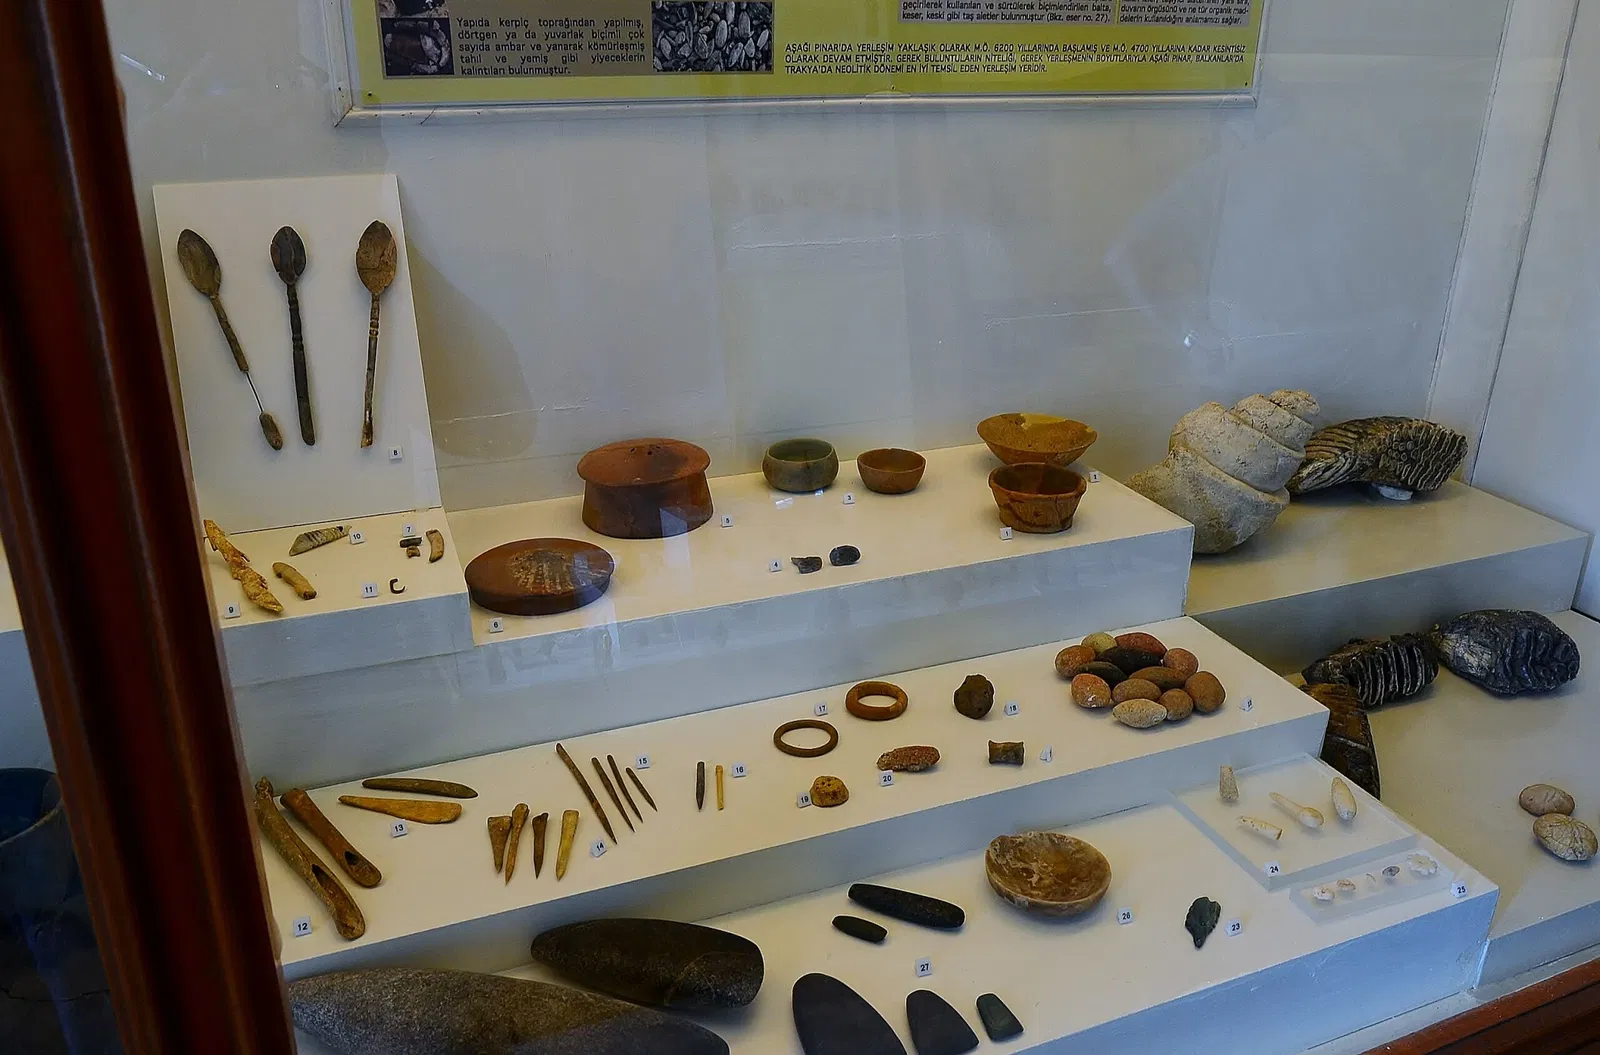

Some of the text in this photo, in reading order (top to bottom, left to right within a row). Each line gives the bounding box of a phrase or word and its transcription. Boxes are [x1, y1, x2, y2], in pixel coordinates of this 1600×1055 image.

[946, 0, 981, 9] kullanılan
[998, 2, 1035, 10] sürtülerek
[1092, 3, 1111, 13] balta,
[903, 11, 923, 20] keser,
[926, 11, 944, 20] keski
[947, 12, 960, 21] gibi
[963, 12, 974, 21] taş
[976, 12, 998, 20] aletler
[1001, 12, 1044, 22] bulunmuştur
[1047, 13, 1063, 22] (Bkz.
[1095, 13, 1110, 23] 27).
[457, 18, 644, 28] Yapıda kerpiç toprağından yapılmış,
[458, 30, 645, 40] dörtgen ya da yuvarlak biçimli çok
[459, 43, 490, 54] sayıda
[495, 43, 525, 51] ambar
[546, 42, 583, 52] yanarak
[588, 42, 645, 52] kömürleşmiş
[785, 42, 810, 54] AŞAĞI
[814, 43, 852, 52] PINAR'DA
[857, 42, 894, 53] YERLEŞİM
[898, 44, 936, 54] YAKLAŞIK
[940, 43, 970, 52] OLARAK
[974, 42, 990, 52] M.Ö.
[994, 43, 1014, 52] 6200
[1017, 43, 1059, 52] YILLARINDA
[1062, 44, 1097, 54] BAŞLAMIŞ
[1101, 44, 1110, 52] VE
[1113, 43, 1127, 52] M.Ö.
[1152, 44, 1185, 53] YILLARINA
[1188, 45, 1210, 53] KADAR
[460, 55, 482, 63] tahıl
[520, 55, 548, 64] yemiş
[561, 54, 578, 64] gibi
[591, 53, 645, 64] yiyeceklerin
[785, 54, 819, 63] OLARAK
[823, 54, 852, 62] DEVAM
[855, 53, 892, 64] ETMİŞTİR.
[896, 54, 921, 62] GEREK
[925, 54, 982, 62] BULUNTULARIN
[1020, 54, 1042, 62] GEREK
[1096, 54, 1146, 62] BOYUTLARIYLA
[1149, 53, 1169, 64] AŞAĞI
[1172, 55, 1192, 64] PINAR,
[1196, 54, 1244, 62] BALKANLAR'DA
[509, 66, 571, 76] bulunmuştur.
[785, 63, 1047, 74] TRAKYA'DA NEOLİTİK DÖNEMİ EN İYİ TEMSİL EDEN YERLEŞİM YERİDİR.
[638, 757, 648, 765] 15
[735, 766, 744, 774] 16
[882, 774, 892, 783] 20
[800, 795, 809, 804] 19
[394, 823, 404, 833] 13
[597, 842, 604, 851] 14
[1269, 865, 1279, 874] 24
[1457, 885, 1466, 894] 25
[1122, 911, 1131, 920] 26
[297, 922, 308, 932] 12
[1231, 922, 1241, 932] 23
[920, 962, 930, 972] 27
